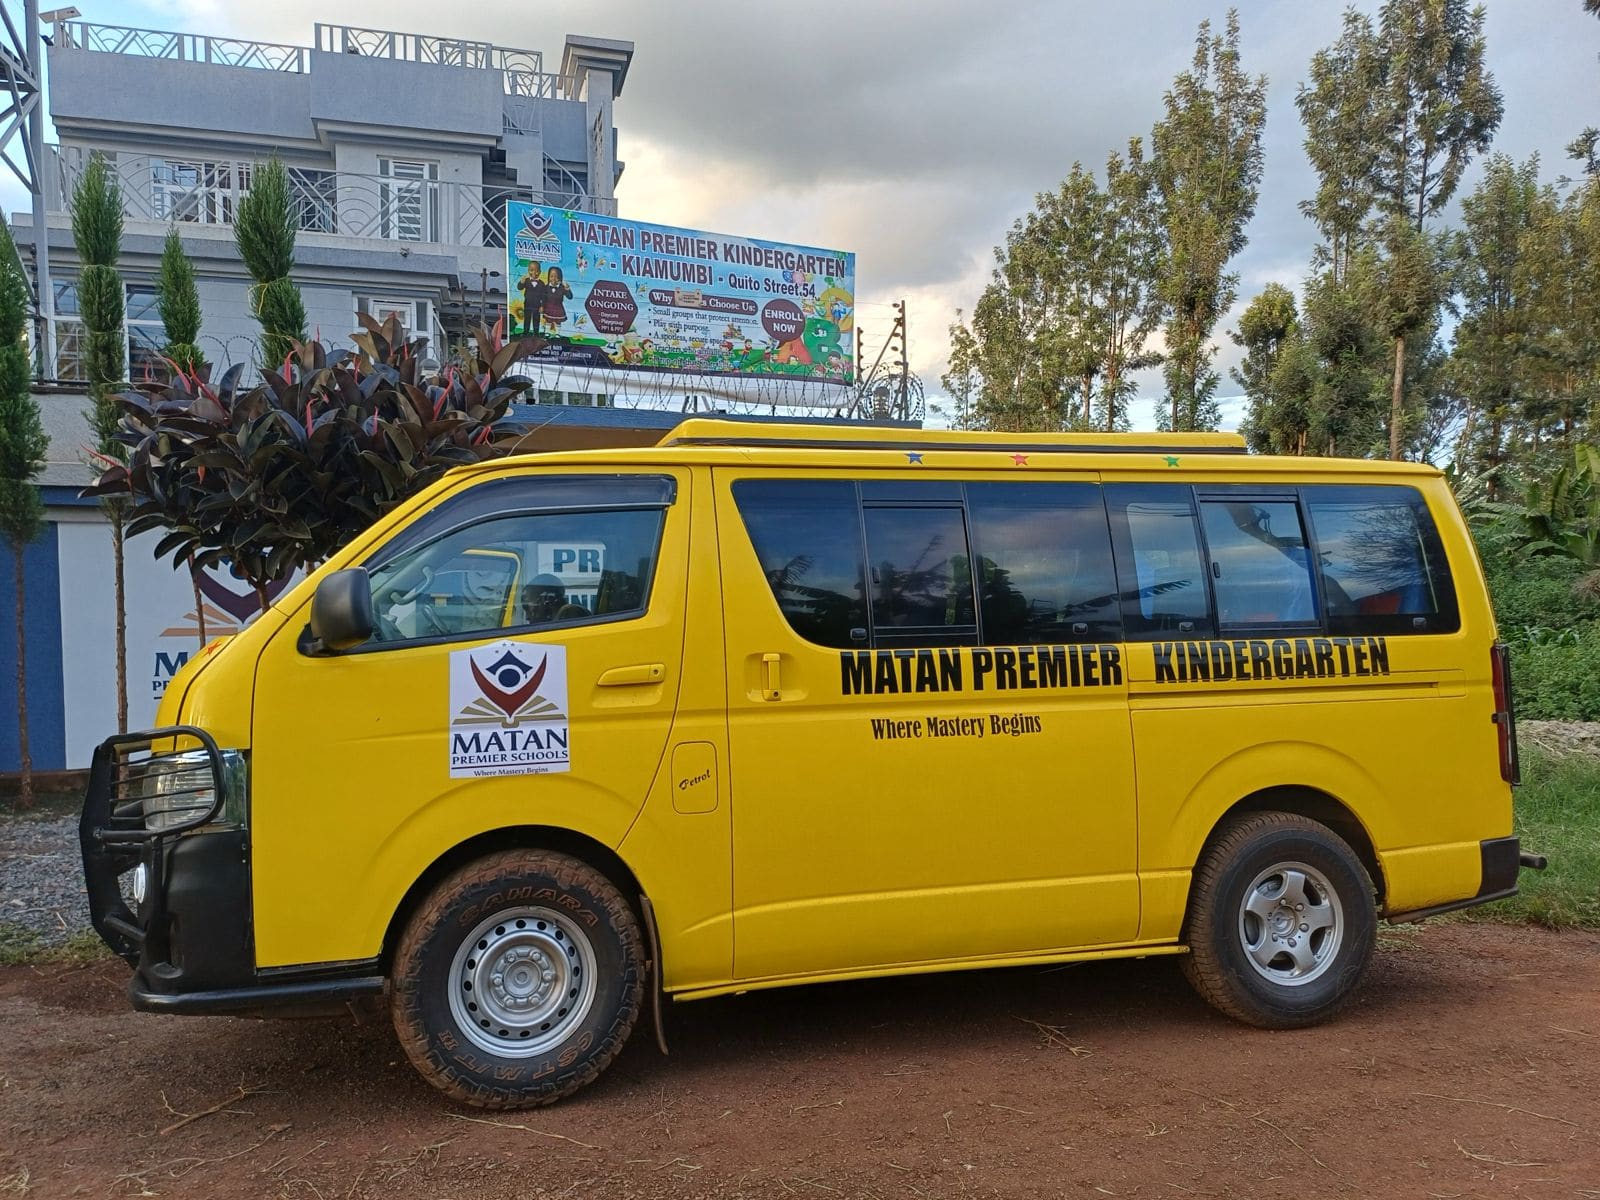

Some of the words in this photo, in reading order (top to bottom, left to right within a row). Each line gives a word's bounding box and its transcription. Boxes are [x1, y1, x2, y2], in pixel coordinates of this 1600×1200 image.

[516, 240, 560, 253] MATAN
[569, 220, 634, 249] MATAN
[641, 230, 718, 260] PREMIER
[723, 243, 845, 278] KINDERGARTEN
[622, 255, 713, 285] KIAMUMBI
[728, 273, 760, 291] Quito
[593, 288, 628, 299] INTAKE
[652, 291, 673, 305] Why
[709, 298, 740, 310] Choose
[742, 301, 756, 312] Us:
[589, 300, 634, 311] ONGOING
[652, 306, 671, 316] Small
[672, 310, 694, 320] groups
[695, 311, 707, 320] that
[764, 308, 803, 322] ENROLL
[773, 322, 796, 334] NOW
[839, 648, 963, 696] MATAN
[970, 644, 1122, 691] PREMIER
[1151, 637, 1390, 684] KINDERGARTEN
[871, 718, 922, 740] Where
[926, 716, 985, 739] Mastery
[990, 712, 1042, 737] Begins
[451, 728, 568, 755] MATAN
[452, 753, 508, 765] PREMIER
[511, 750, 568, 761] SCHOOLS
[473, 769, 497, 777] Where
[498, 768, 526, 776] Mastery
[527, 767, 549, 775] Begins
[678, 769, 711, 791] Petrol
[457, 886, 599, 928] SAHARA
